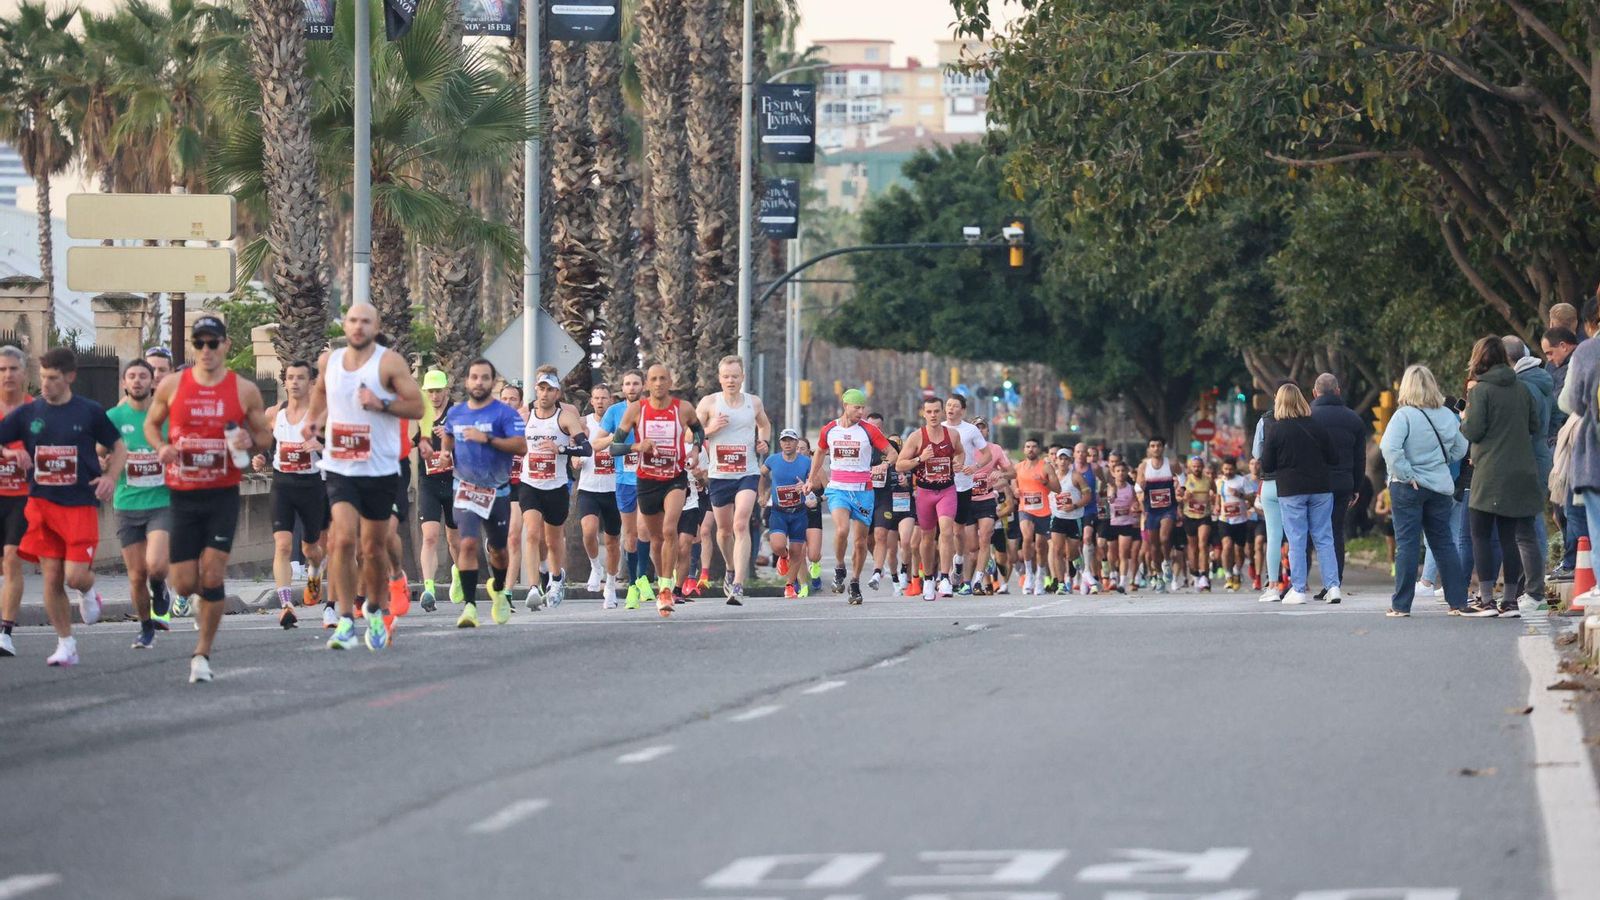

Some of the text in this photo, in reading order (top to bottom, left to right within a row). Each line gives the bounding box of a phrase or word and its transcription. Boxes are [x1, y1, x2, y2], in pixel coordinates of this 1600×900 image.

[310, 25, 319, 33] 15
[496, 23, 512, 31] FEB
[45, 459, 67, 469] 4758
[133, 464, 158, 473] 17525
